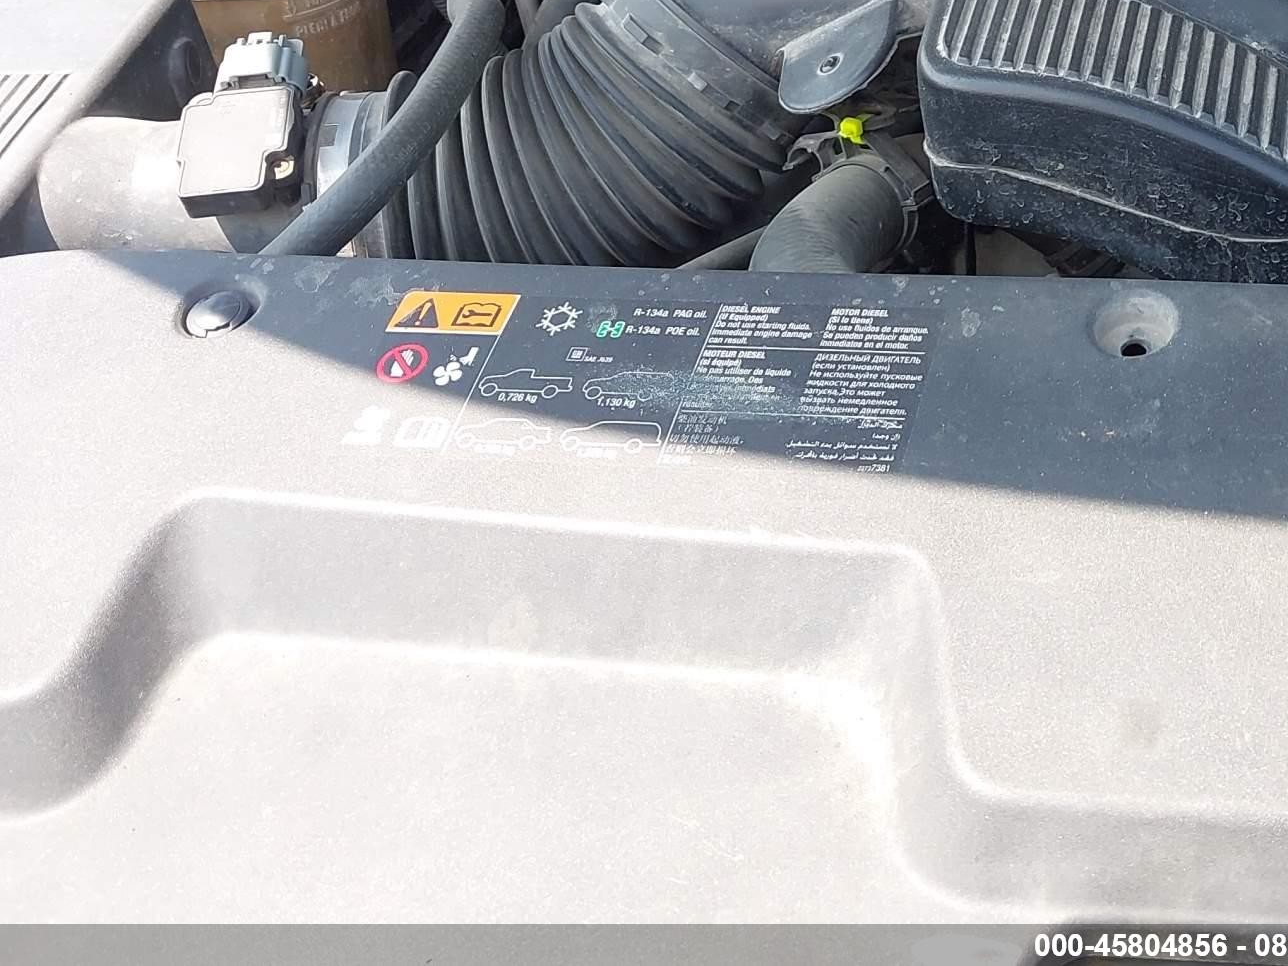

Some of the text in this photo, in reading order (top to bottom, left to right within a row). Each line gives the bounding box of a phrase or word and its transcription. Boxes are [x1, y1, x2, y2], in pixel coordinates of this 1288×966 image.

[633, 308, 708, 319] R-134a PAG oil.
[721, 305, 782, 314] DIESEL ENGINE
[831, 308, 889, 317] MOTOR DIESEL
[729, 313, 769, 322] Equipped)
[851, 317, 873, 325] tiene)
[715, 320, 727, 328] Do
[727, 321, 741, 329] not
[757, 321, 787, 331] starting
[787, 322, 811, 330] fluids.
[854, 324, 880, 332] fluidos
[881, 325, 891, 333] de
[892, 326, 929, 335] arranque.
[625, 326, 700, 336] R-134a POE oil.
[711, 328, 813, 340] Immediate engine damage
[823, 331, 922, 342] Se pueden producir daños
[884, 342, 908, 350] motor.
[703, 350, 766, 359] MOTEUR DIESEL
[814, 353, 921, 364] ДИЗЕЛЬНЫЙ ДВИГАТЕЛЬ
[812, 361, 891, 372] (если установлен)
[707, 367, 724, 375] pas
[764, 368, 792, 377] liquide
[809, 369, 923, 382] Не используйте пусковые
[849, 380, 867, 388] для
[868, 381, 916, 390] холодного
[856, 389, 886, 397] может
[525, 393, 538, 404] kg
[623, 397, 637, 408] kg
[837, 397, 899, 406] немедленное
